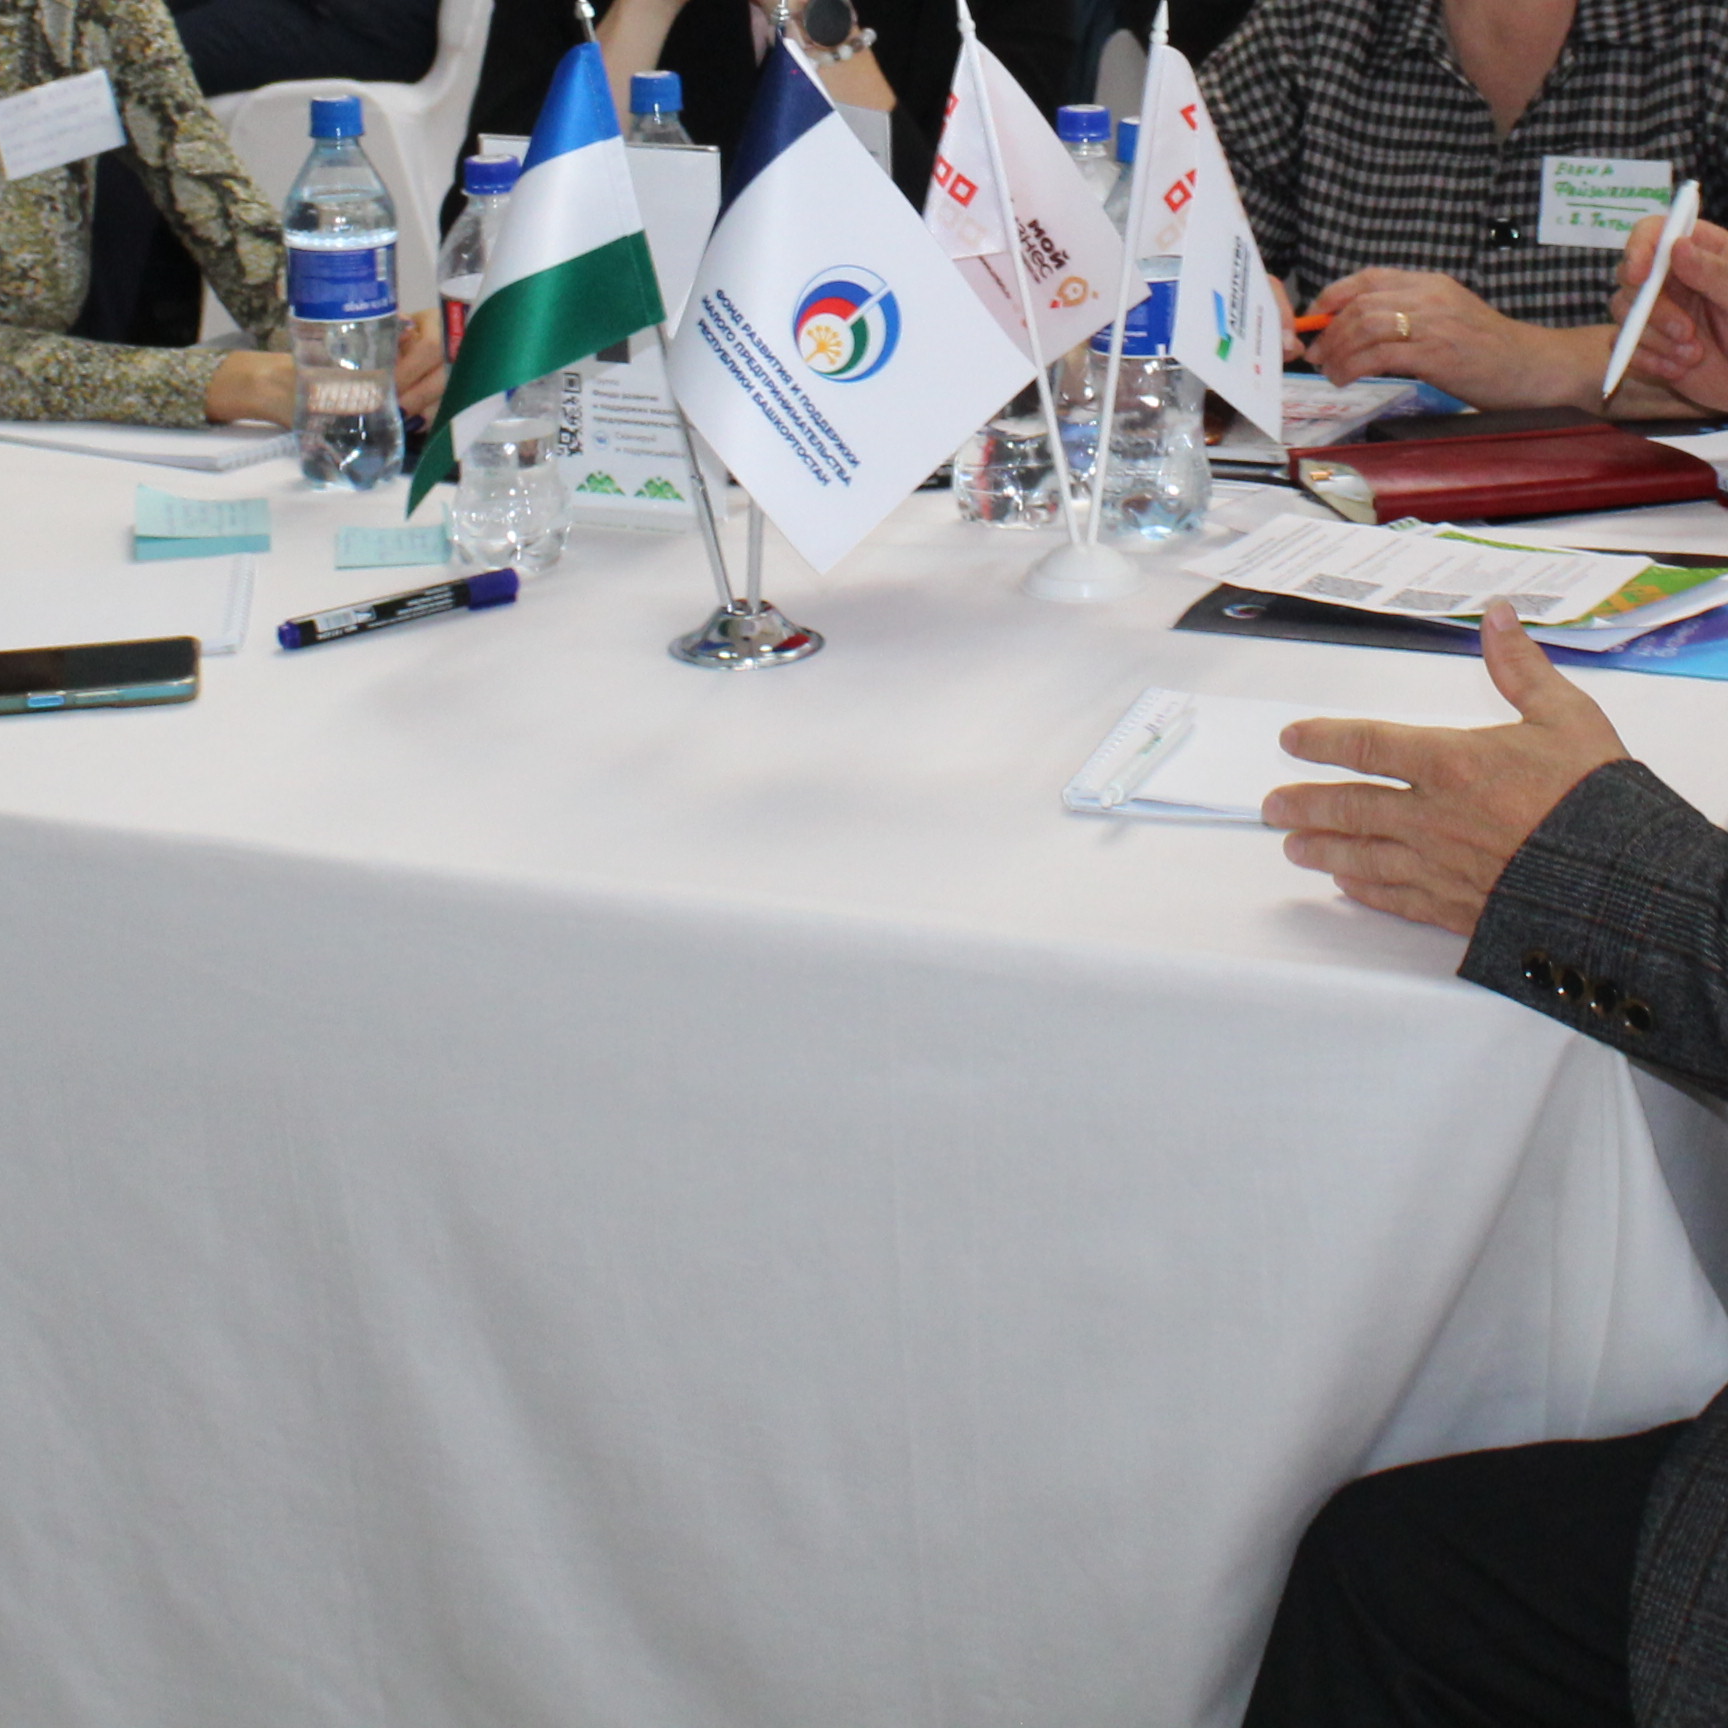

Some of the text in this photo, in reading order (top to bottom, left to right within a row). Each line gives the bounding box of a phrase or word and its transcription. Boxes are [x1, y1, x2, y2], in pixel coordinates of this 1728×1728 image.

[698, 317, 831, 487] РЕСПУБЛИКИ БАШКОРТОСТАН
[702, 294, 852, 487] МАЛОГО ПРЕДПРИНИМАТЕЛЬСТВА
[715, 288, 861, 469] ФОНД РАЗВИТИЯ И ПОДДЕРЖКИ
